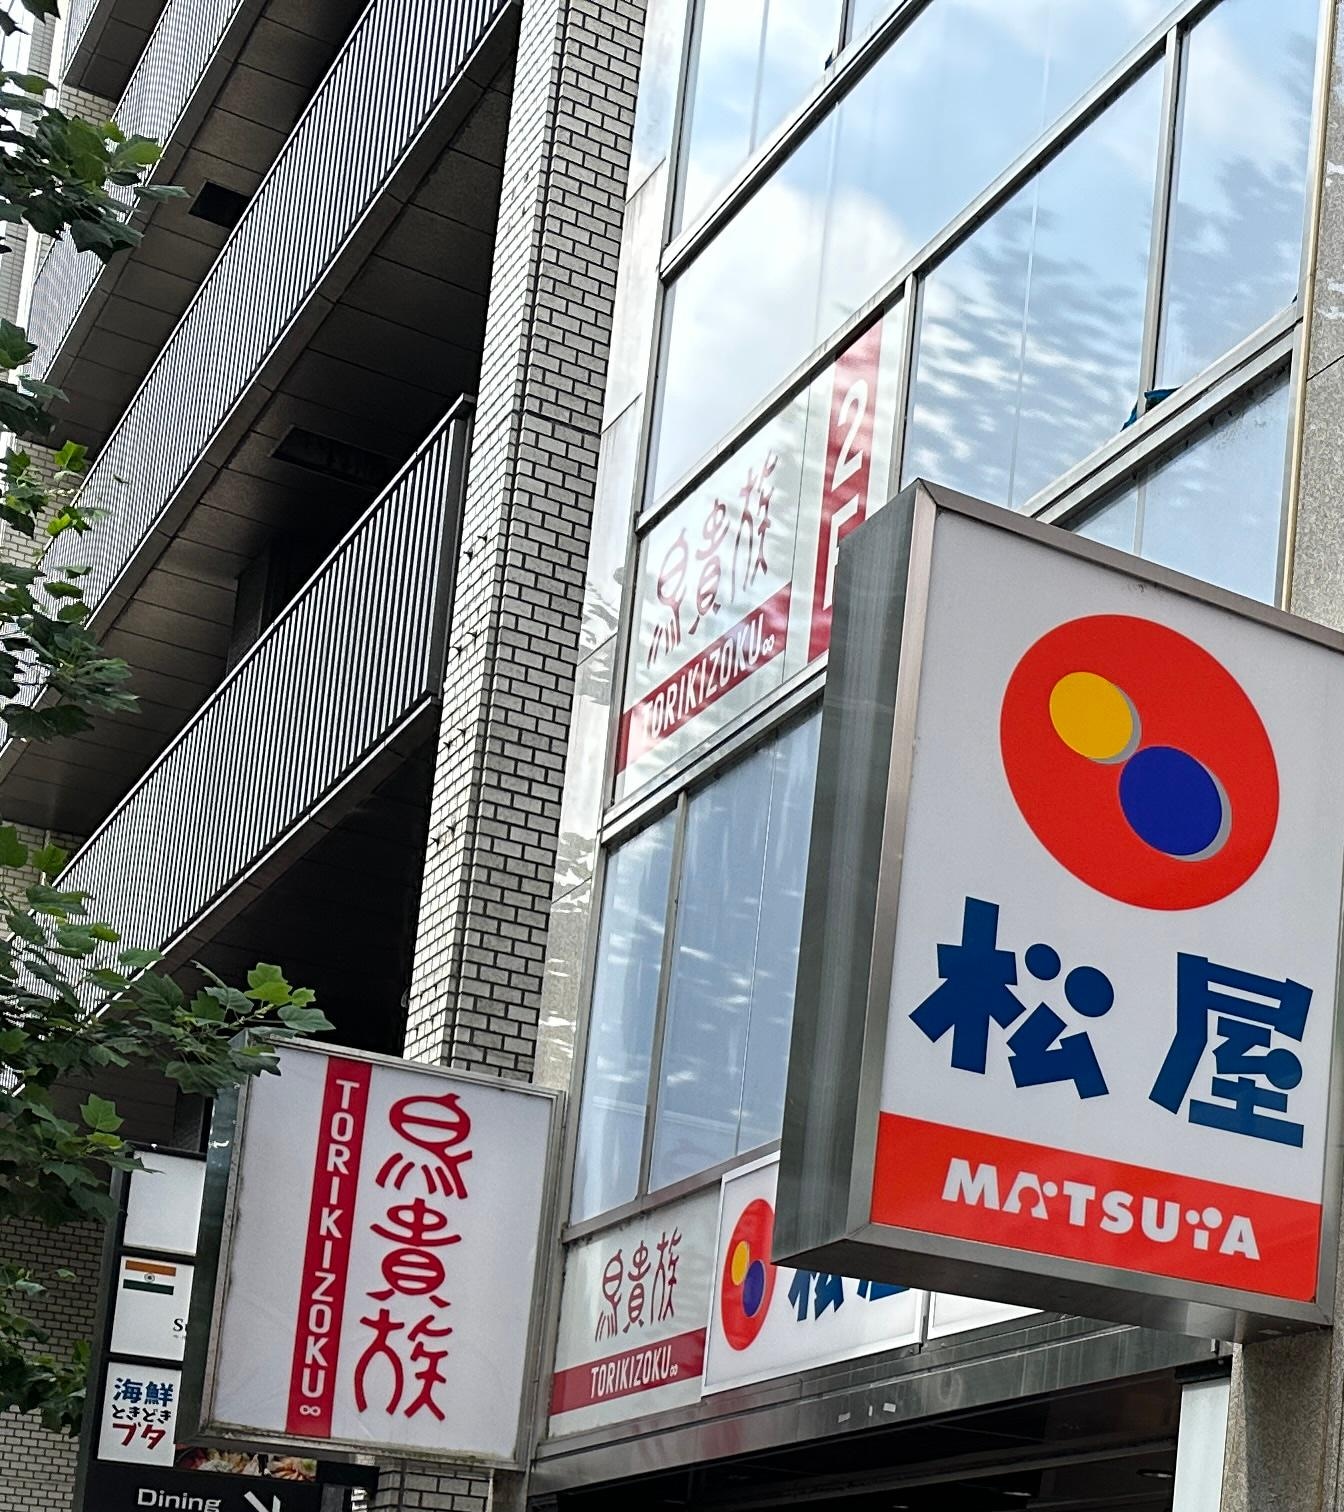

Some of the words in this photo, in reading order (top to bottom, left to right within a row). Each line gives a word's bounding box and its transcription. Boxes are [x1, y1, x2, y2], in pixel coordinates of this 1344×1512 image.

[640, 614, 765, 741] TORIKIZOKU
[909, 893, 1314, 1148] 松屋
[301, 1078, 361, 1400] TORIKIZOKU
[941, 1156, 1261, 1261] MATSUYA
[113, 1377, 174, 1408] 海鮮
[589, 1345, 672, 1400] TORIKIZOKU
[111, 1404, 172, 1423] ときどき
[111, 1421, 167, 1449] ブタ
